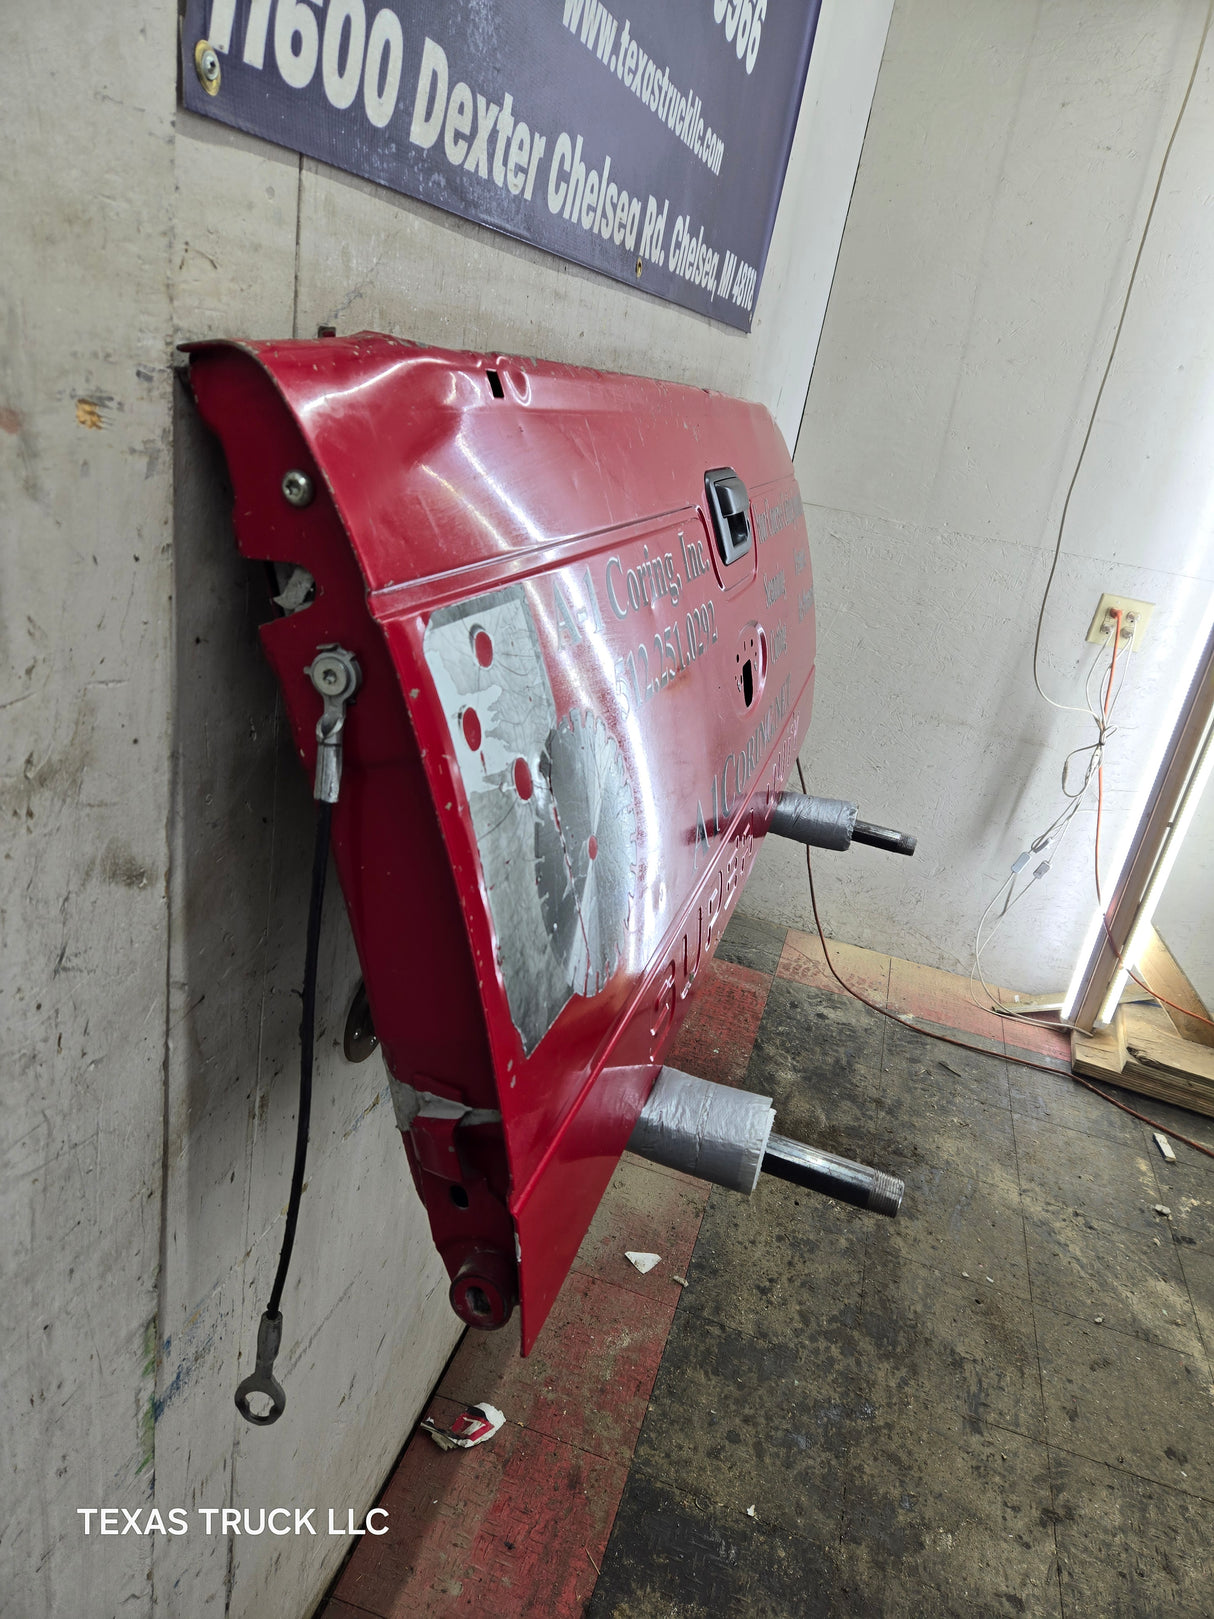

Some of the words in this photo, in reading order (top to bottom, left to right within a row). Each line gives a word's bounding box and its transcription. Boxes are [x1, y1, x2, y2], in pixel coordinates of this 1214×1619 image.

[409, 37, 546, 201] Dexter
[548, 132, 642, 251] Chelsea
[639, 194, 670, 267] Rd.
[668, 214, 720, 302] Chelsea,
[717, 249, 738, 300] MI
[553, 563, 606, 651] A-1
[606, 545, 683, 620] Coring,
[677, 531, 710, 583] Inc.
[614, 600, 718, 721] 512.251.0292
